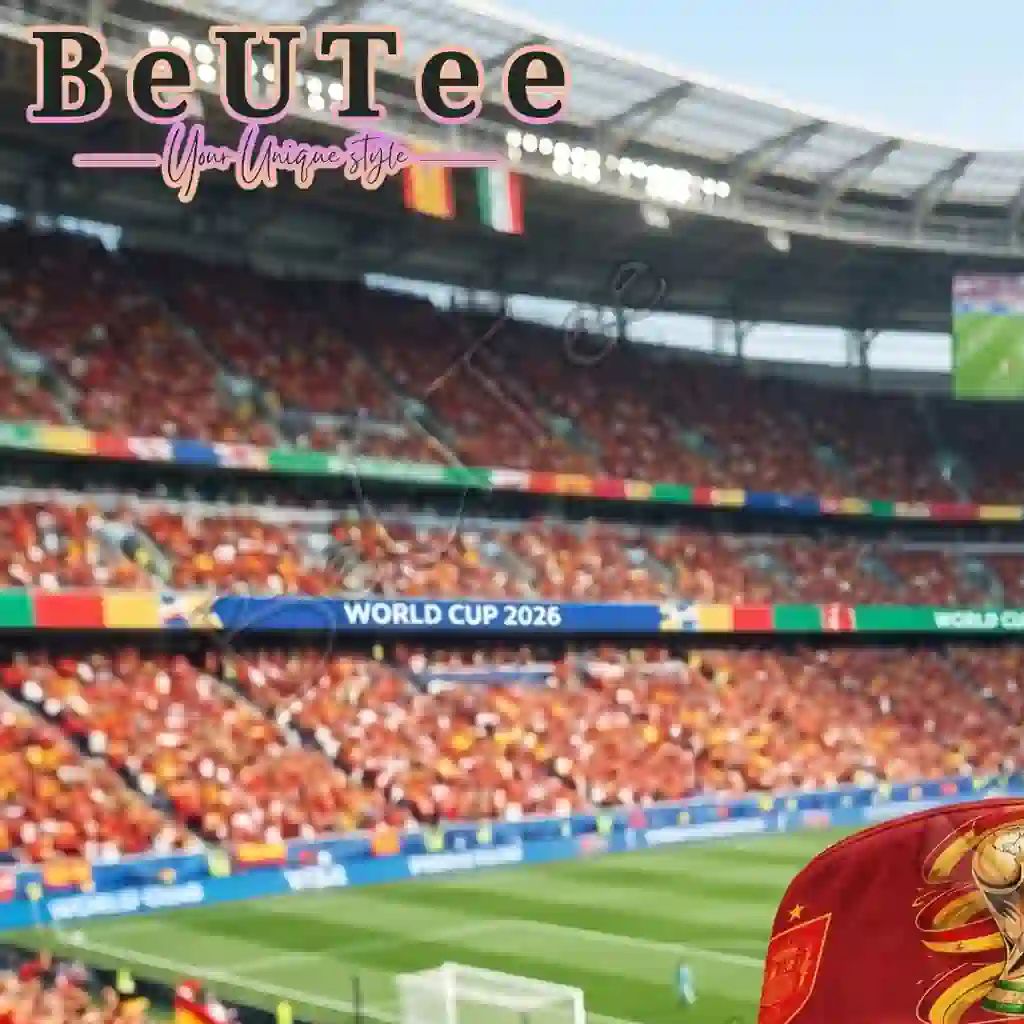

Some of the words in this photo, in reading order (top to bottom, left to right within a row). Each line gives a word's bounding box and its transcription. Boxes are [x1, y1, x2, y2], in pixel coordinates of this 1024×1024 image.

[343, 602, 442, 625] WORLD
[448, 603, 499, 625] CUP
[503, 604, 562, 626] 2026
